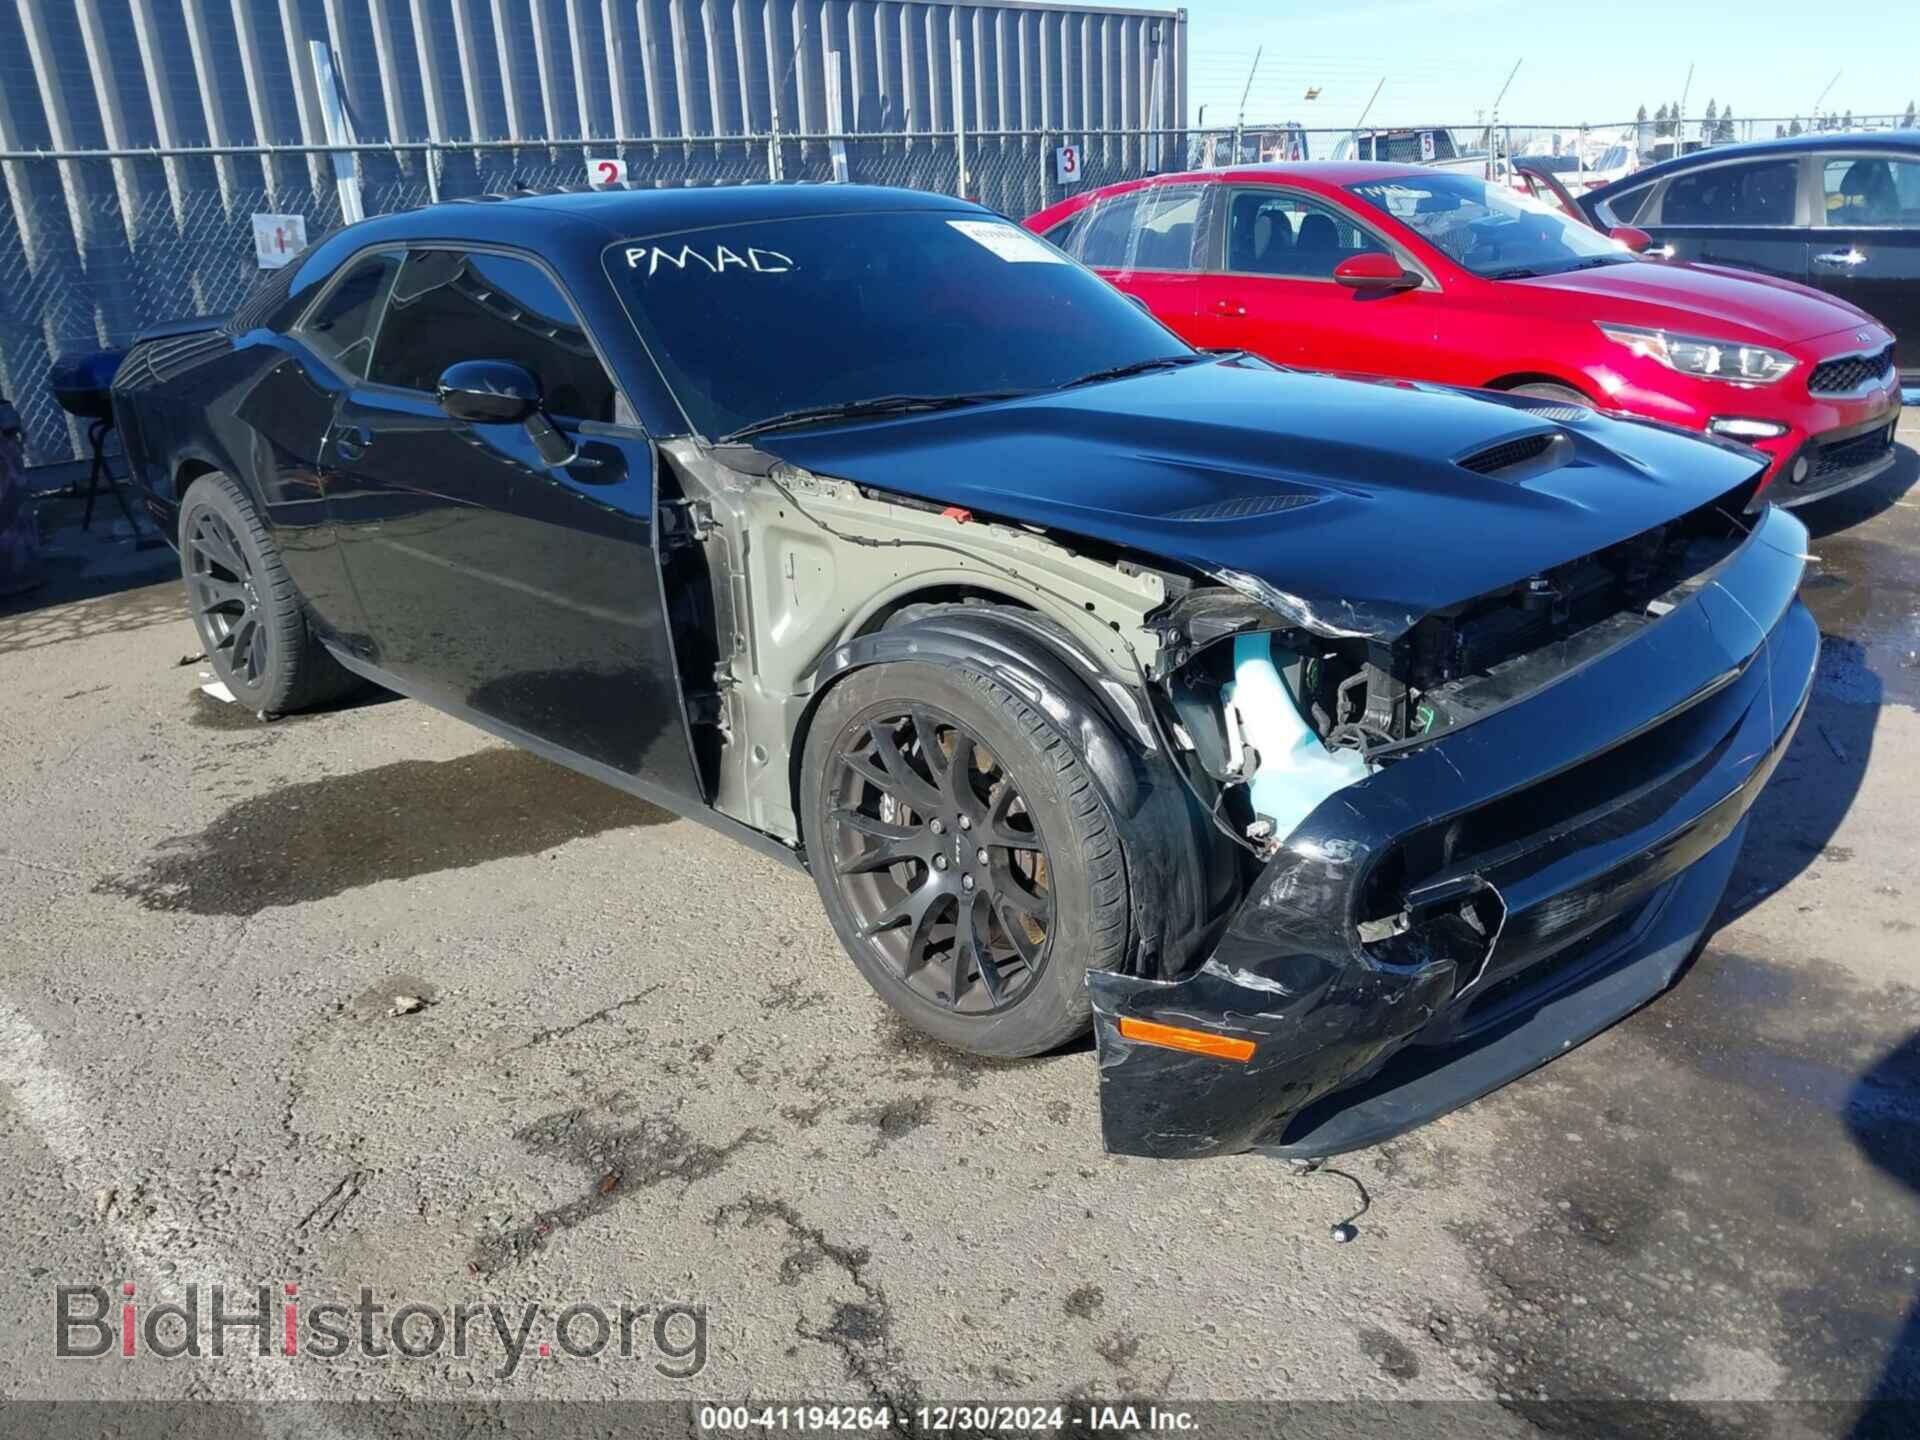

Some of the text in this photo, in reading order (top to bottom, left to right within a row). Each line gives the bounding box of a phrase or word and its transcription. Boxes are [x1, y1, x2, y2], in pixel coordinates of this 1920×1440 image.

[1424, 134, 1432, 153] 5
[1063, 148, 1075, 173] 3
[598, 162, 618, 184] 2
[625, 244, 794, 276] PMAD
